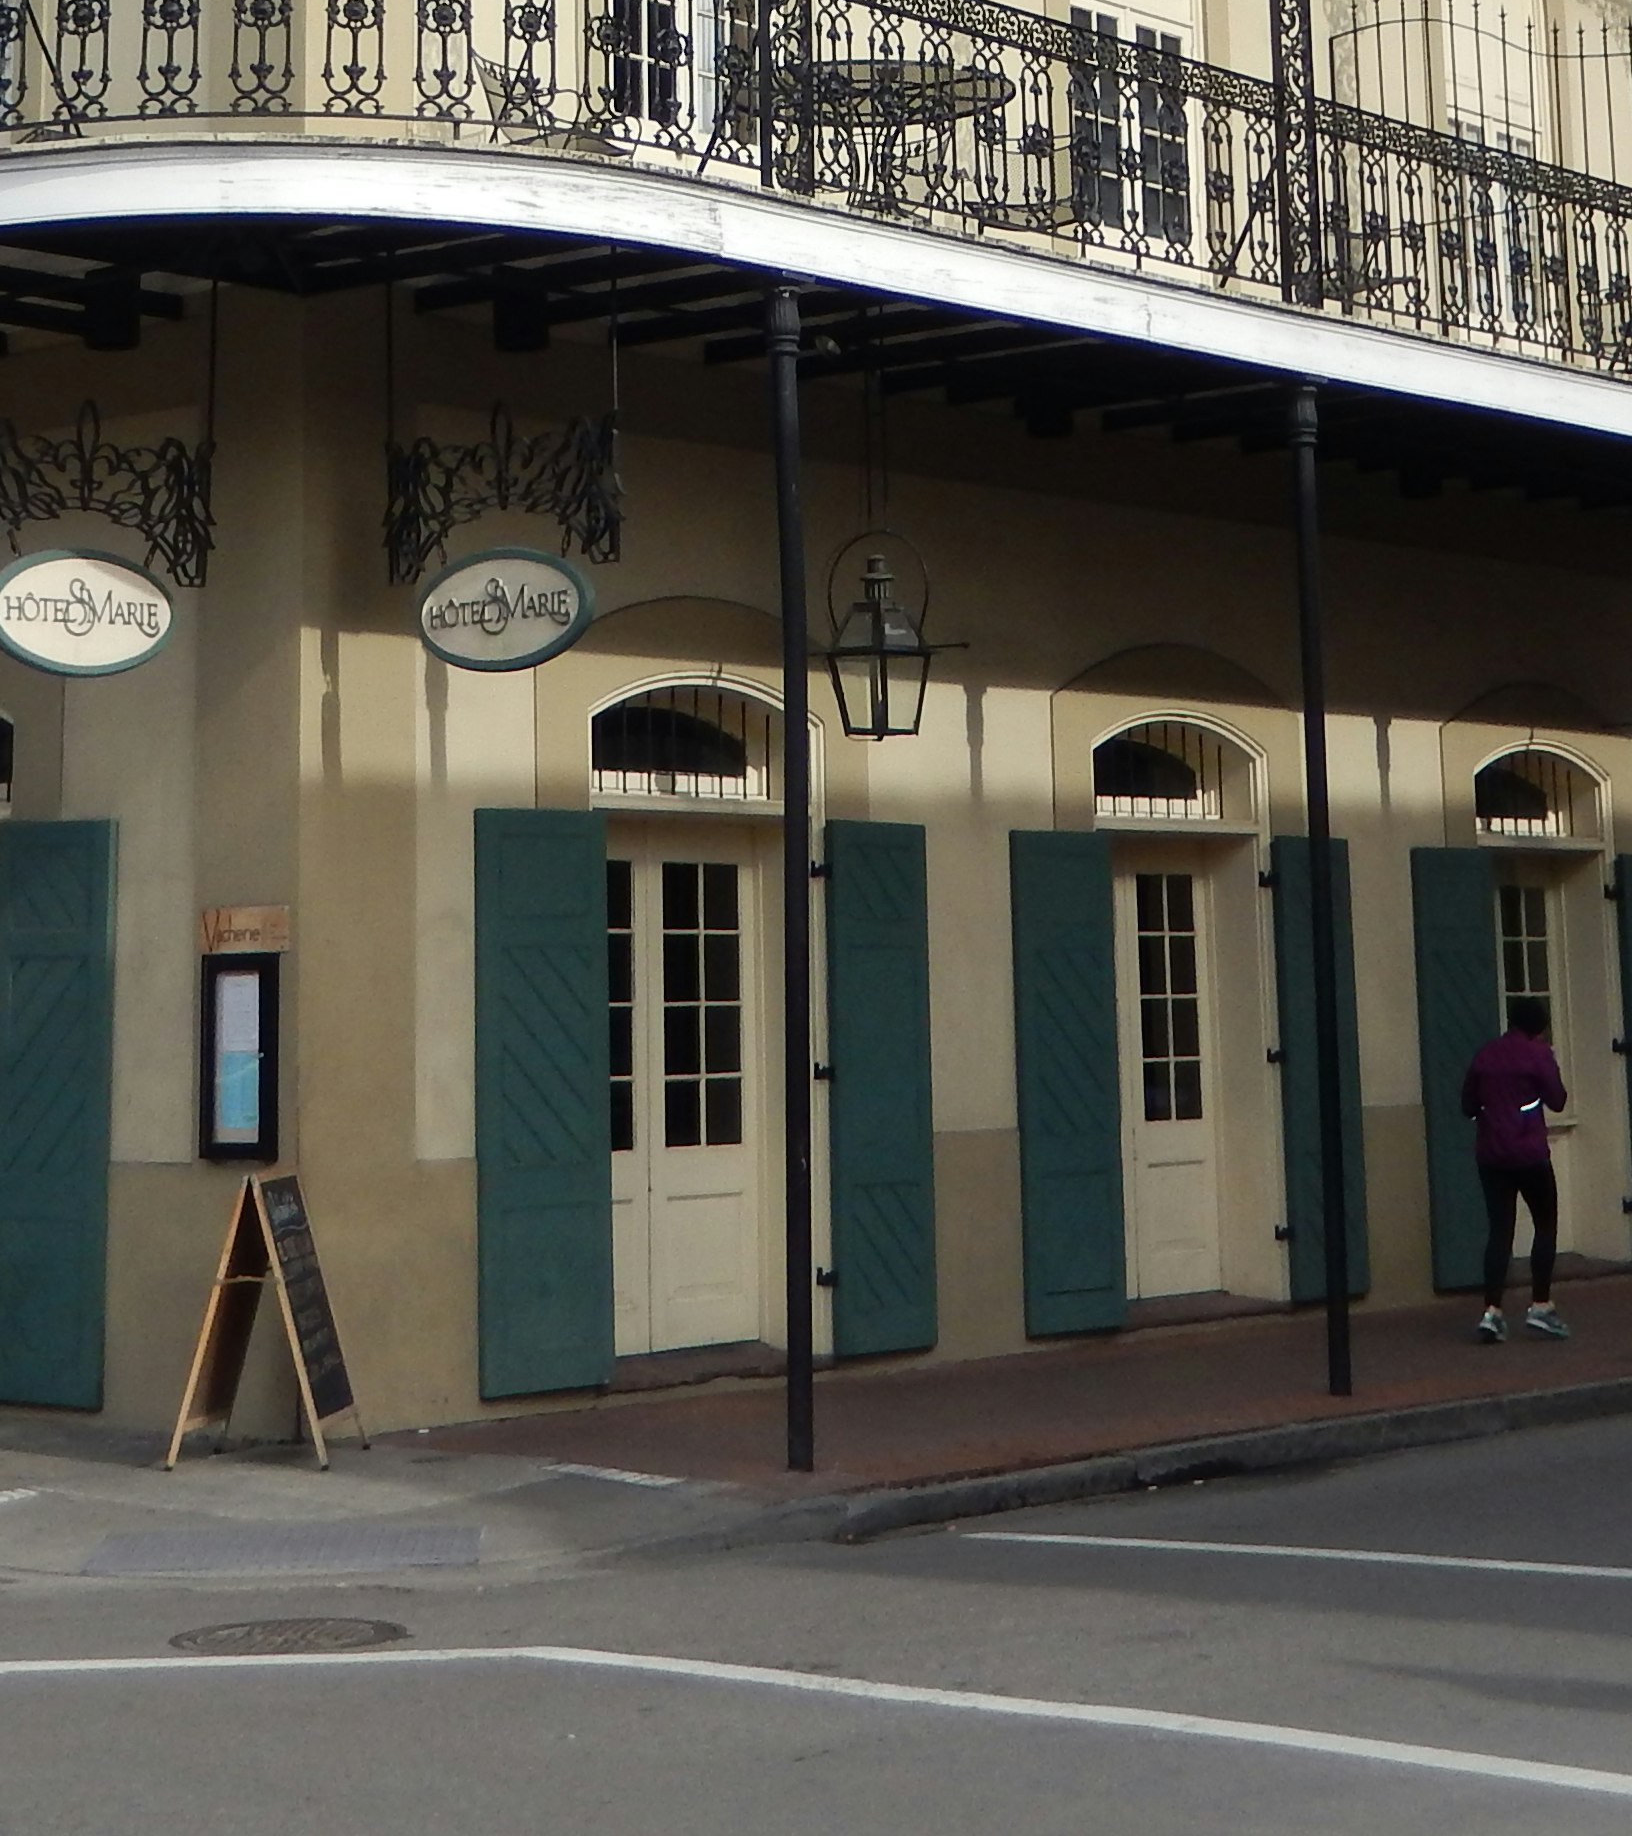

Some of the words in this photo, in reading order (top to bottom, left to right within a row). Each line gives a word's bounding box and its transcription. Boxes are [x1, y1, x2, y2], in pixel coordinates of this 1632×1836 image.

[3, 591, 77, 624] HÔTEL
[84, 588, 161, 638] MARIE
[500, 583, 571, 626] MARIE
